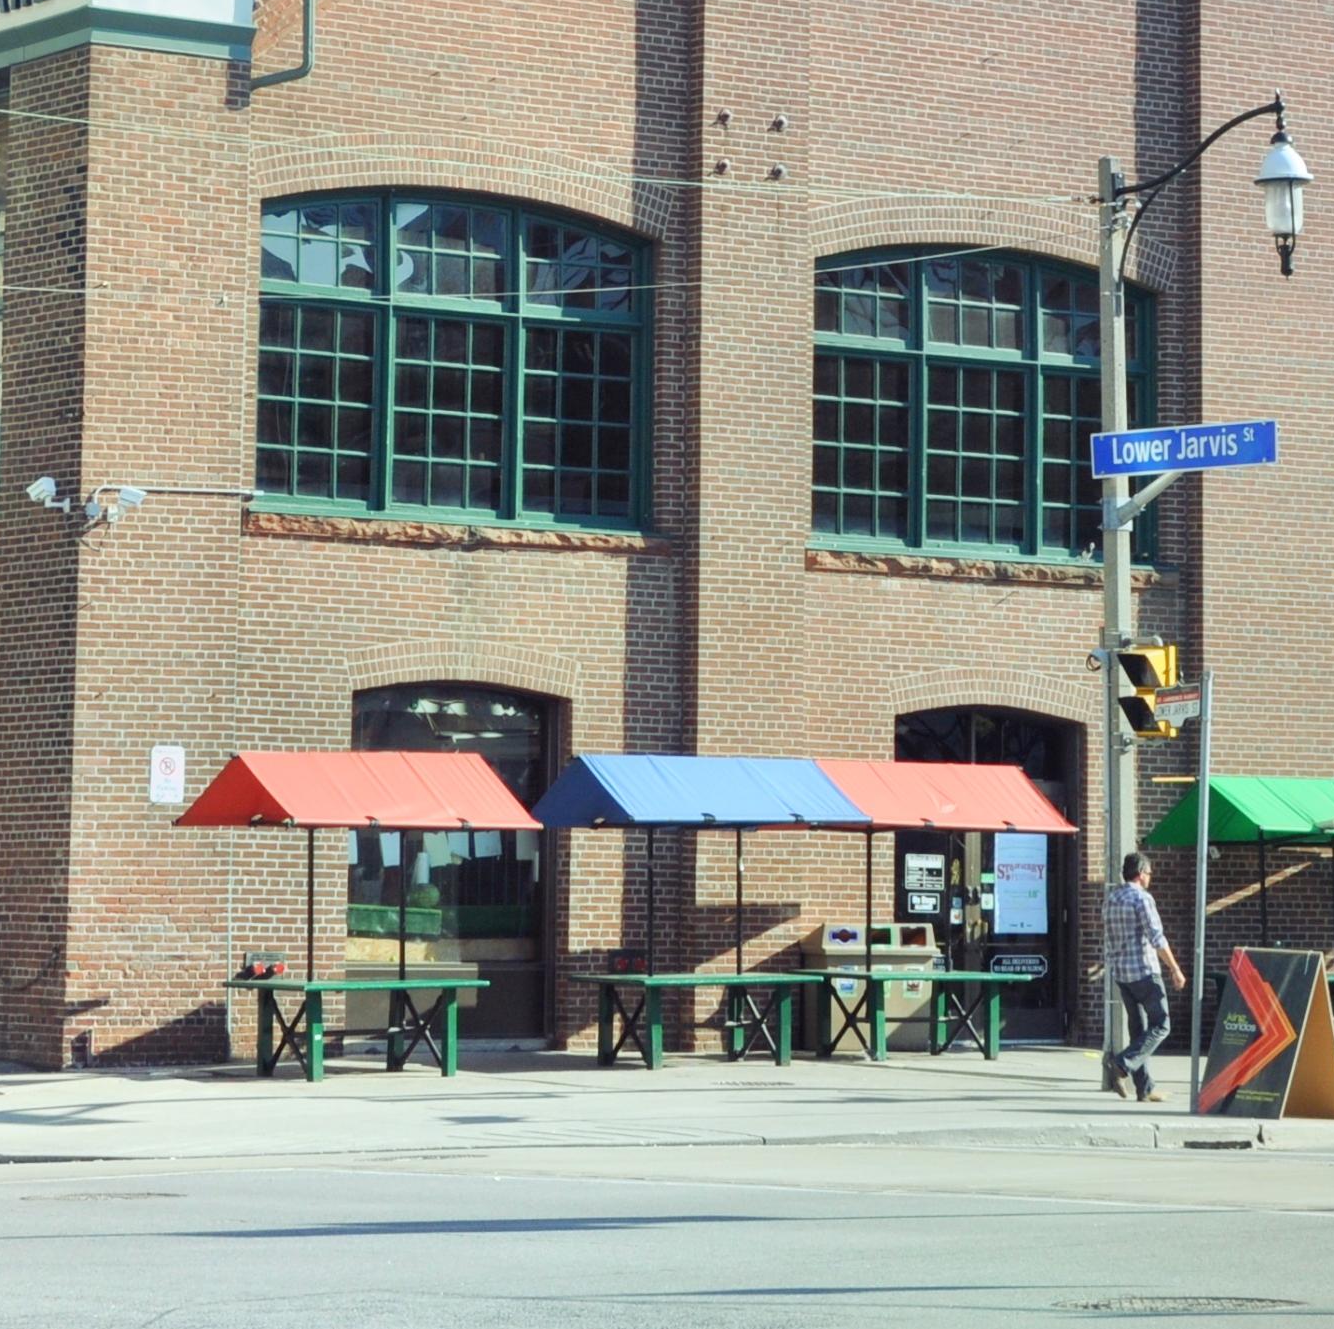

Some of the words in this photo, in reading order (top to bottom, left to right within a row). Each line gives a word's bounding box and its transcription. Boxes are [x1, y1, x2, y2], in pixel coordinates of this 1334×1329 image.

[1112, 437, 1172, 465] Lower
[1176, 428, 1238, 461] Jarvis
[1243, 426, 1255, 442] St
